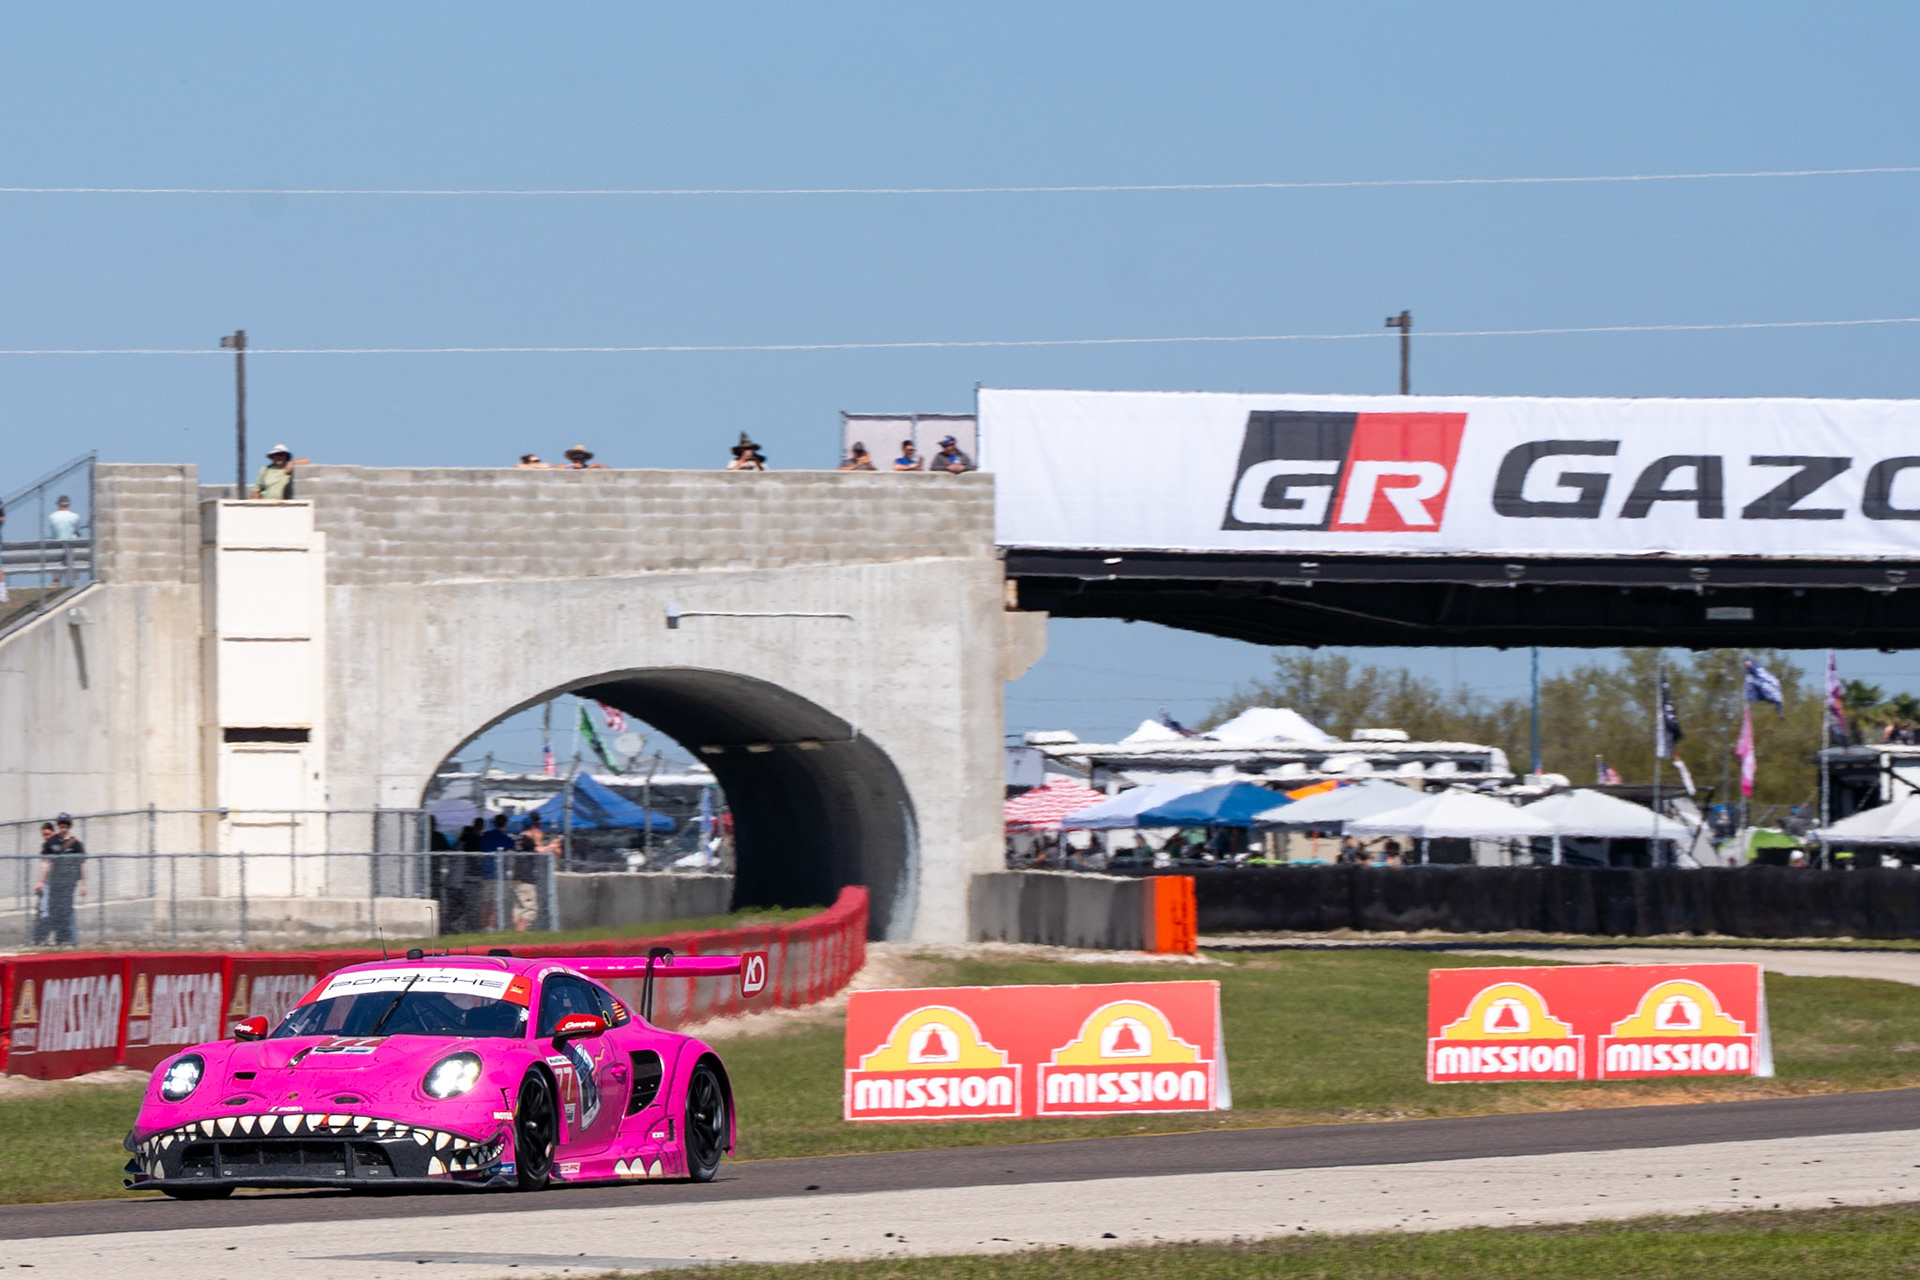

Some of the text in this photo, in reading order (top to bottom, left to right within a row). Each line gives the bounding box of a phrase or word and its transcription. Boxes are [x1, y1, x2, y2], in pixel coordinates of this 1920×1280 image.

[1231, 460, 1447, 525] GR
[328, 975, 505, 991] PORSCHE
[1436, 1045, 1577, 1075] MISSION
[1606, 1043, 1749, 1072] MISSION
[854, 1076, 1013, 1110] MISSION
[1046, 1071, 1207, 1104] MISSION
